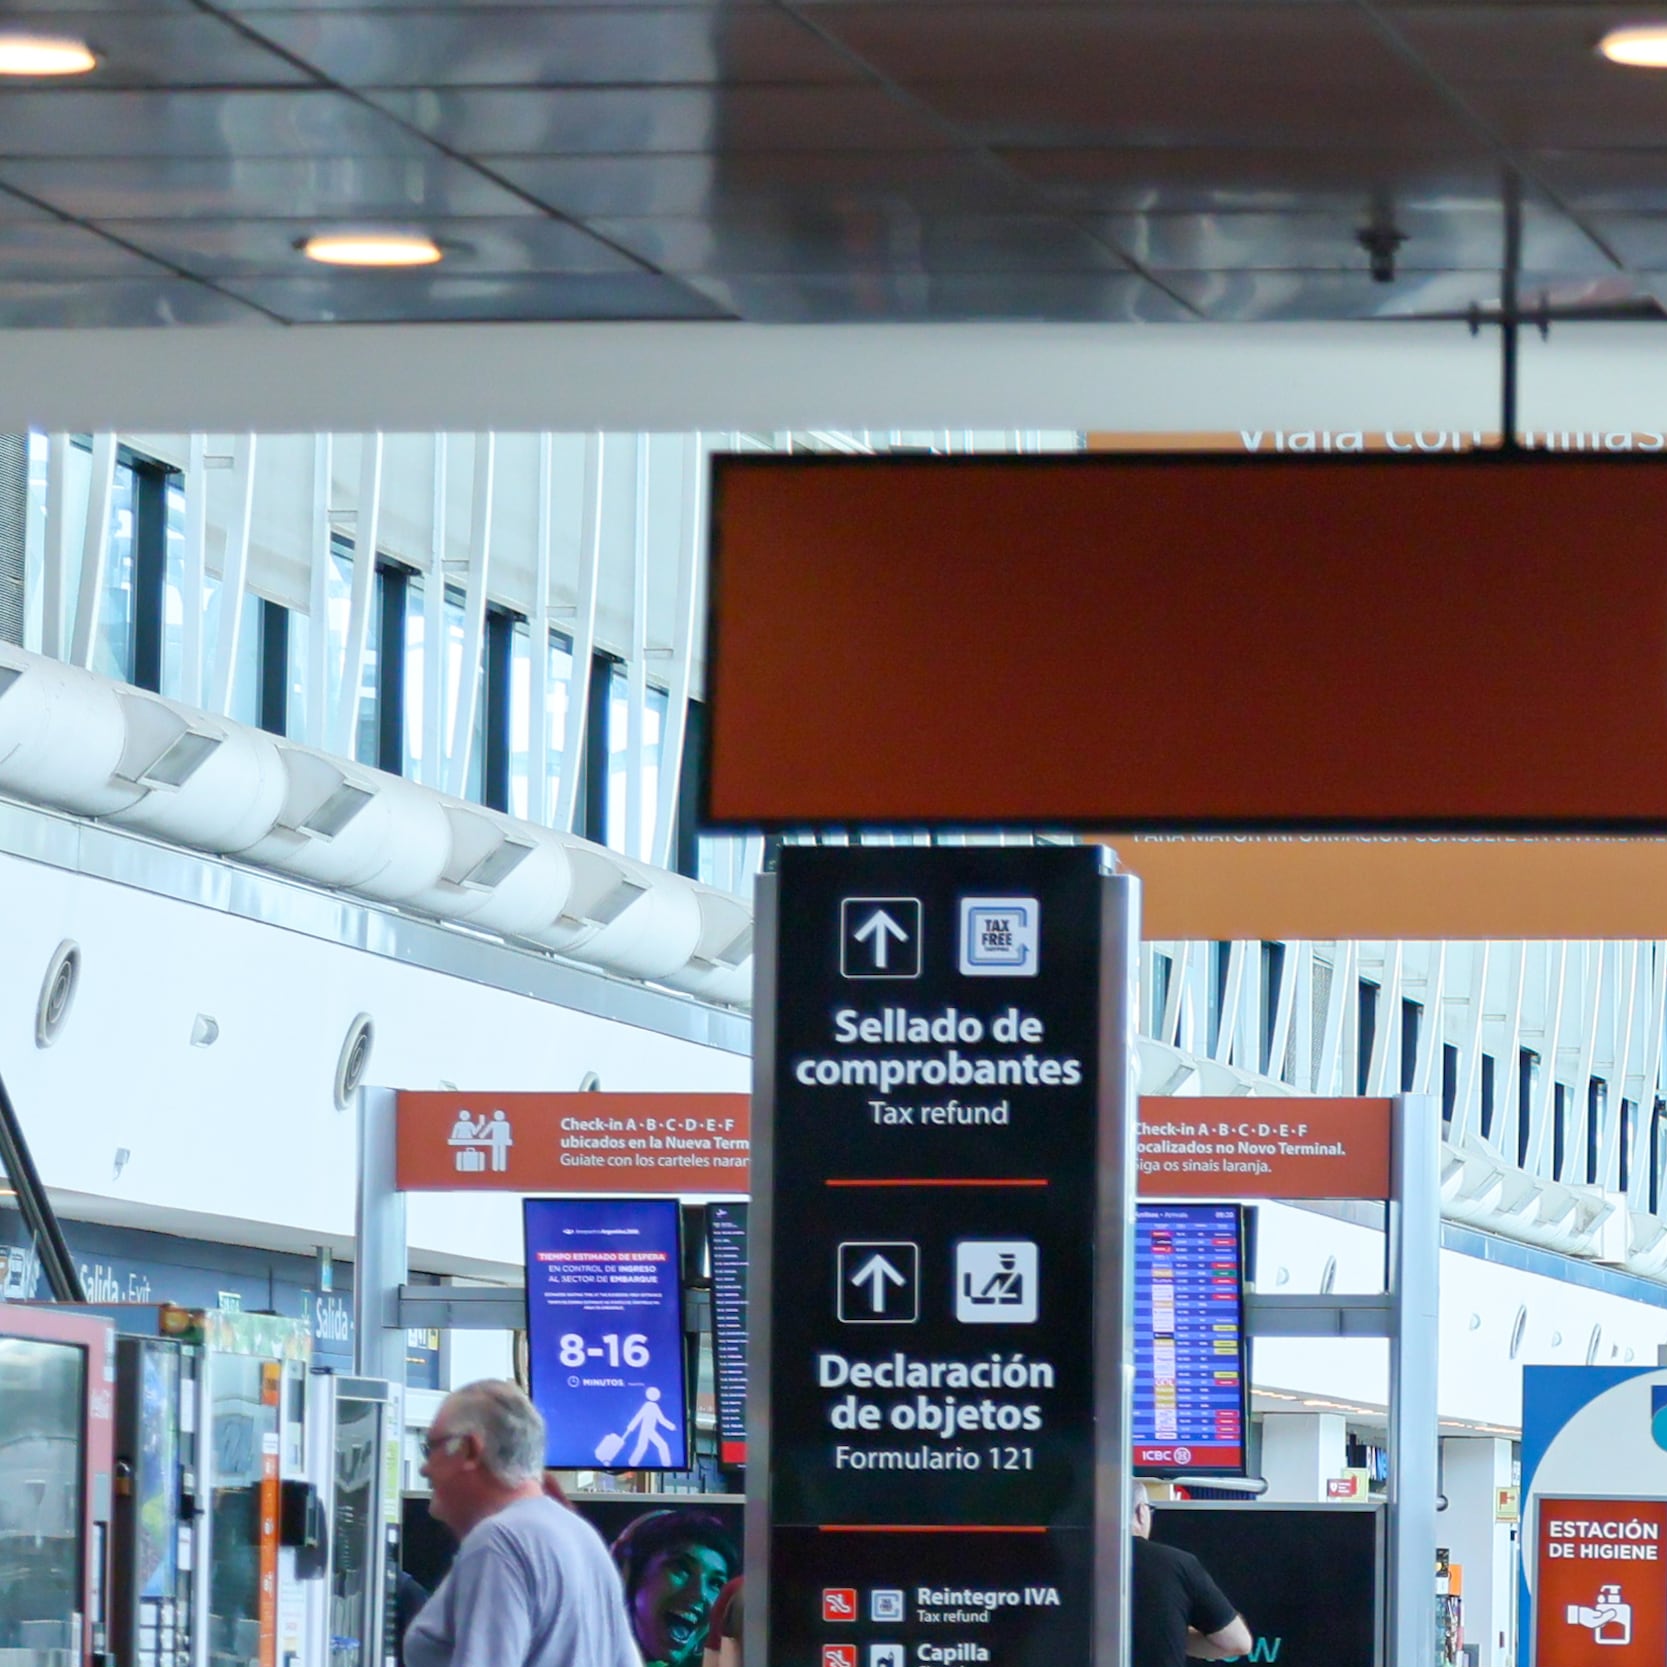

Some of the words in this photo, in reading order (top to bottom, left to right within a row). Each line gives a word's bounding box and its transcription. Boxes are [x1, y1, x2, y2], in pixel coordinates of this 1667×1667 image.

[984, 919, 1010, 933] TAX
[982, 933, 1012, 946] FREE
[835, 1008, 983, 1043] Sellado
[993, 1008, 1043, 1043] de
[796, 1050, 1082, 1094] comprobantes
[869, 1101, 913, 1125] Tax
[921, 1100, 1009, 1125] refund
[561, 1118, 623, 1132] Check-in
[626, 1118, 636, 1132] A
[646, 1119, 655, 1132] B
[666, 1119, 676, 1132] C
[685, 1119, 696, 1132] D
[707, 1119, 715, 1132] E
[725, 1119, 734, 1132] F
[561, 1135, 625, 1150] ubicados
[629, 1139, 646, 1150] en
[650, 1136, 661, 1150] la
[666, 1138, 711, 1150] Nueva
[1216, 1144, 1234, 1155] no
[1238, 1142, 1276, 1155] Novo
[1278, 1142, 1346, 1156] Terminal.
[608, 1156, 631, 1166] con
[635, 1154, 655, 1166] los
[658, 1154, 710, 1167] carteles
[1164, 1162, 1179, 1172] os
[1182, 1160, 1220, 1172] sinais
[1223, 1160, 1272, 1175] laranja.
[315, 1296, 348, 1341] Salida
[559, 1334, 650, 1367] 8-16
[819, 1353, 1054, 1388] Declaración
[583, 1378, 624, 1387] MINUTOS
[831, 1395, 881, 1430] de
[891, 1395, 1042, 1438] objetos
[835, 1446, 979, 1470] Formulario
[989, 1448, 1033, 1470] 121
[1142, 1450, 1171, 1461] ICBC
[1549, 1518, 1658, 1539] ESTACIÓN
[1549, 1543, 1574, 1558] DE
[1580, 1544, 1658, 1560] HIGIENE
[917, 1588, 1020, 1611] Reintegro
[1024, 1588, 1060, 1606] IVA
[917, 1610, 940, 1622] Tax
[944, 1610, 989, 1623] refund
[917, 1644, 990, 1665] Capilla
